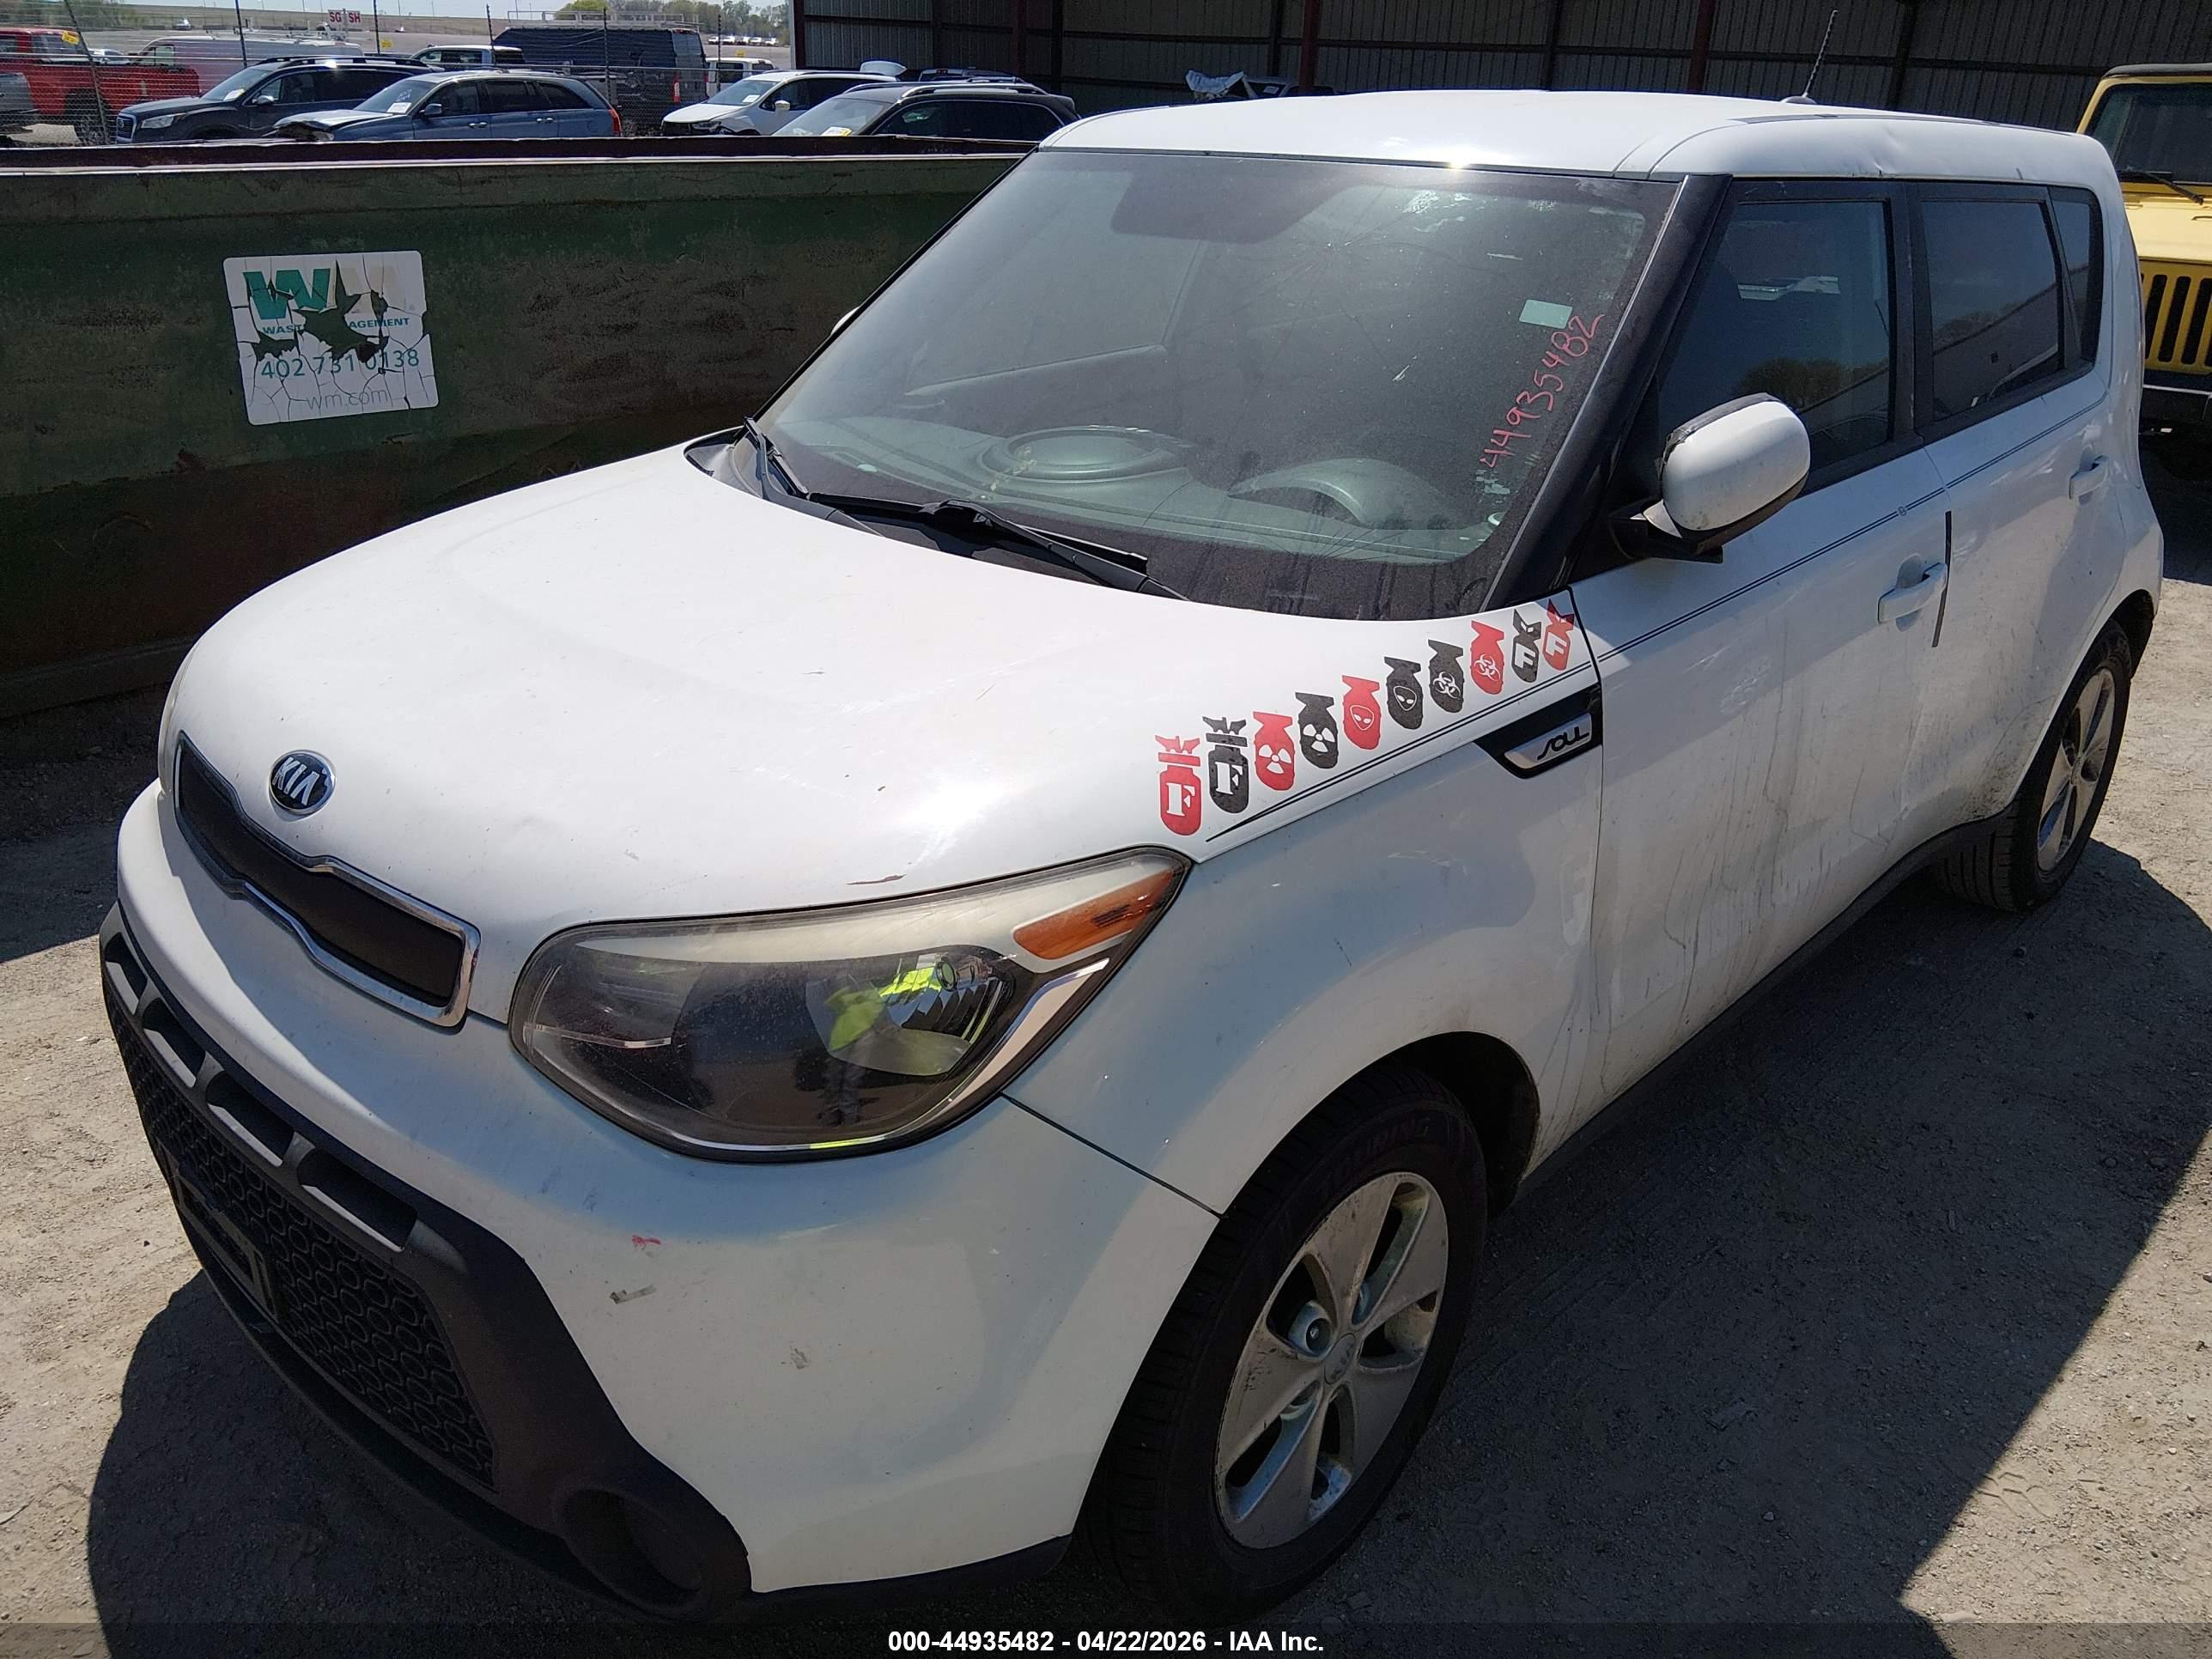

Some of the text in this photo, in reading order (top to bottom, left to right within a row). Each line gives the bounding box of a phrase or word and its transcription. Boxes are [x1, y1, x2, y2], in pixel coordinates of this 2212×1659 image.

[329, 11, 361, 23] SG SH
[263, 317, 410, 334] WAST AGEMENT
[261, 349, 419, 379] 402 731 0138
[307, 389, 388, 410] wm.com
[1479, 314, 1605, 468] 44935482
[1514, 642, 1536, 669] F
[1546, 631, 1567, 657] F
[1536, 725, 1590, 762] SOUL
[271, 757, 320, 806] KIA
[1215, 762, 1244, 795] F
[1166, 782, 1196, 817] F
